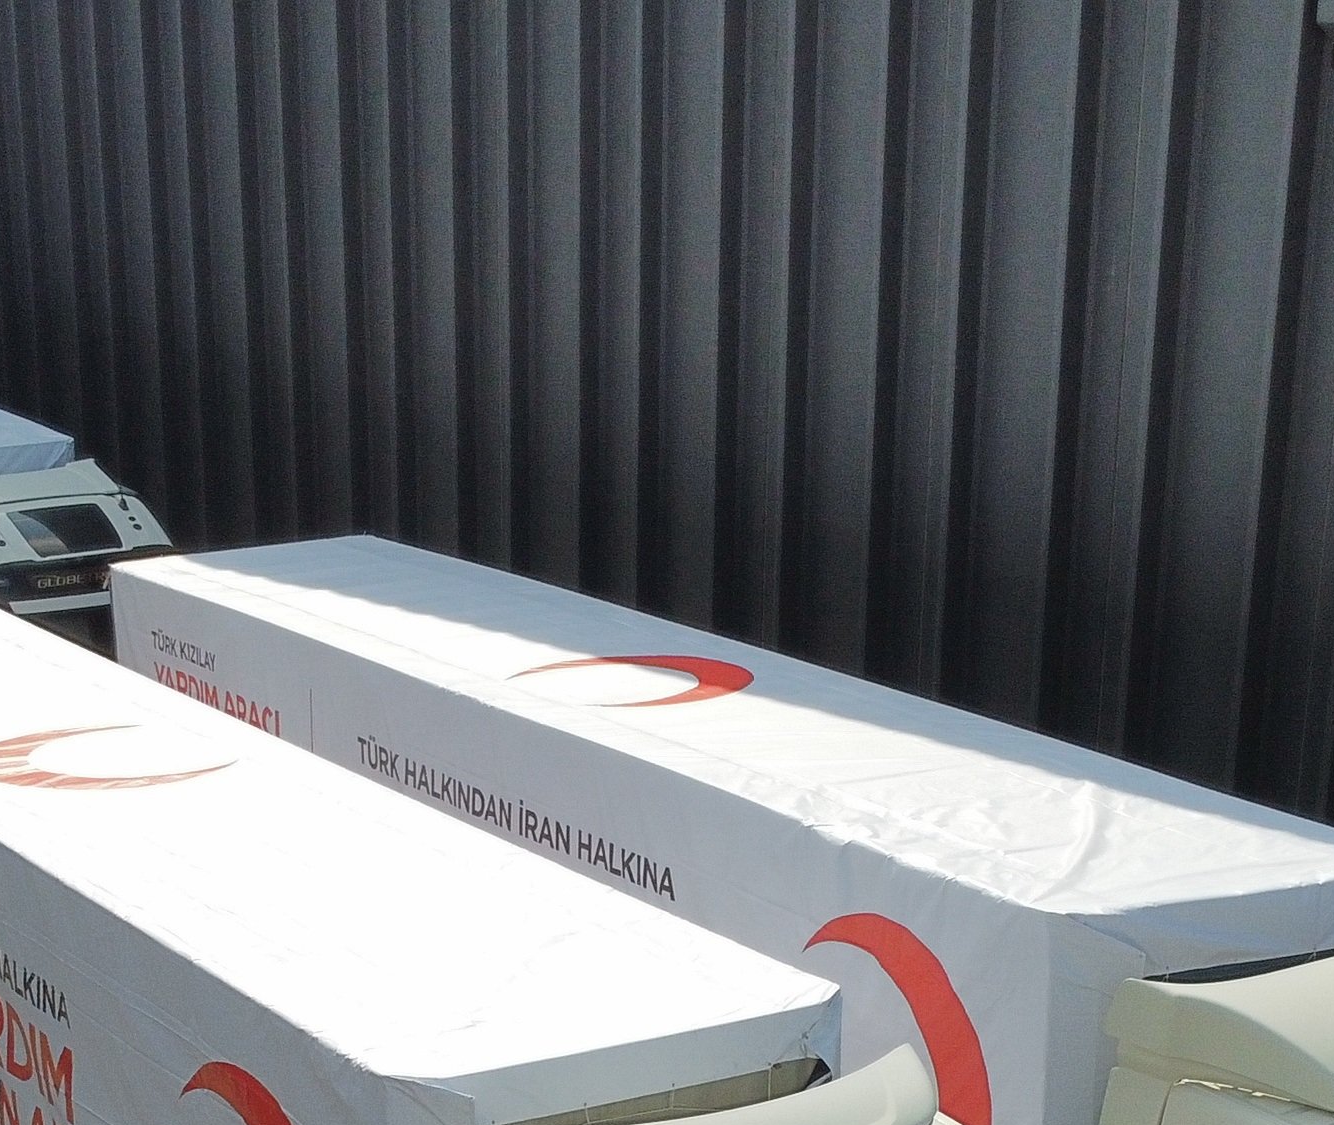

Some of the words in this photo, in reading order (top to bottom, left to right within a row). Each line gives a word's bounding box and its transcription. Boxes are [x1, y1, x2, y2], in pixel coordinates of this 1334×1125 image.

[151, 629, 177, 657] TÜRK
[179, 642, 216, 672] KIZILAY
[357, 735, 400, 781] TÜRK
[404, 758, 512, 831] HALKINDAN
[519, 799, 570, 855] İRAN
[578, 829, 675, 901] HALKINA
